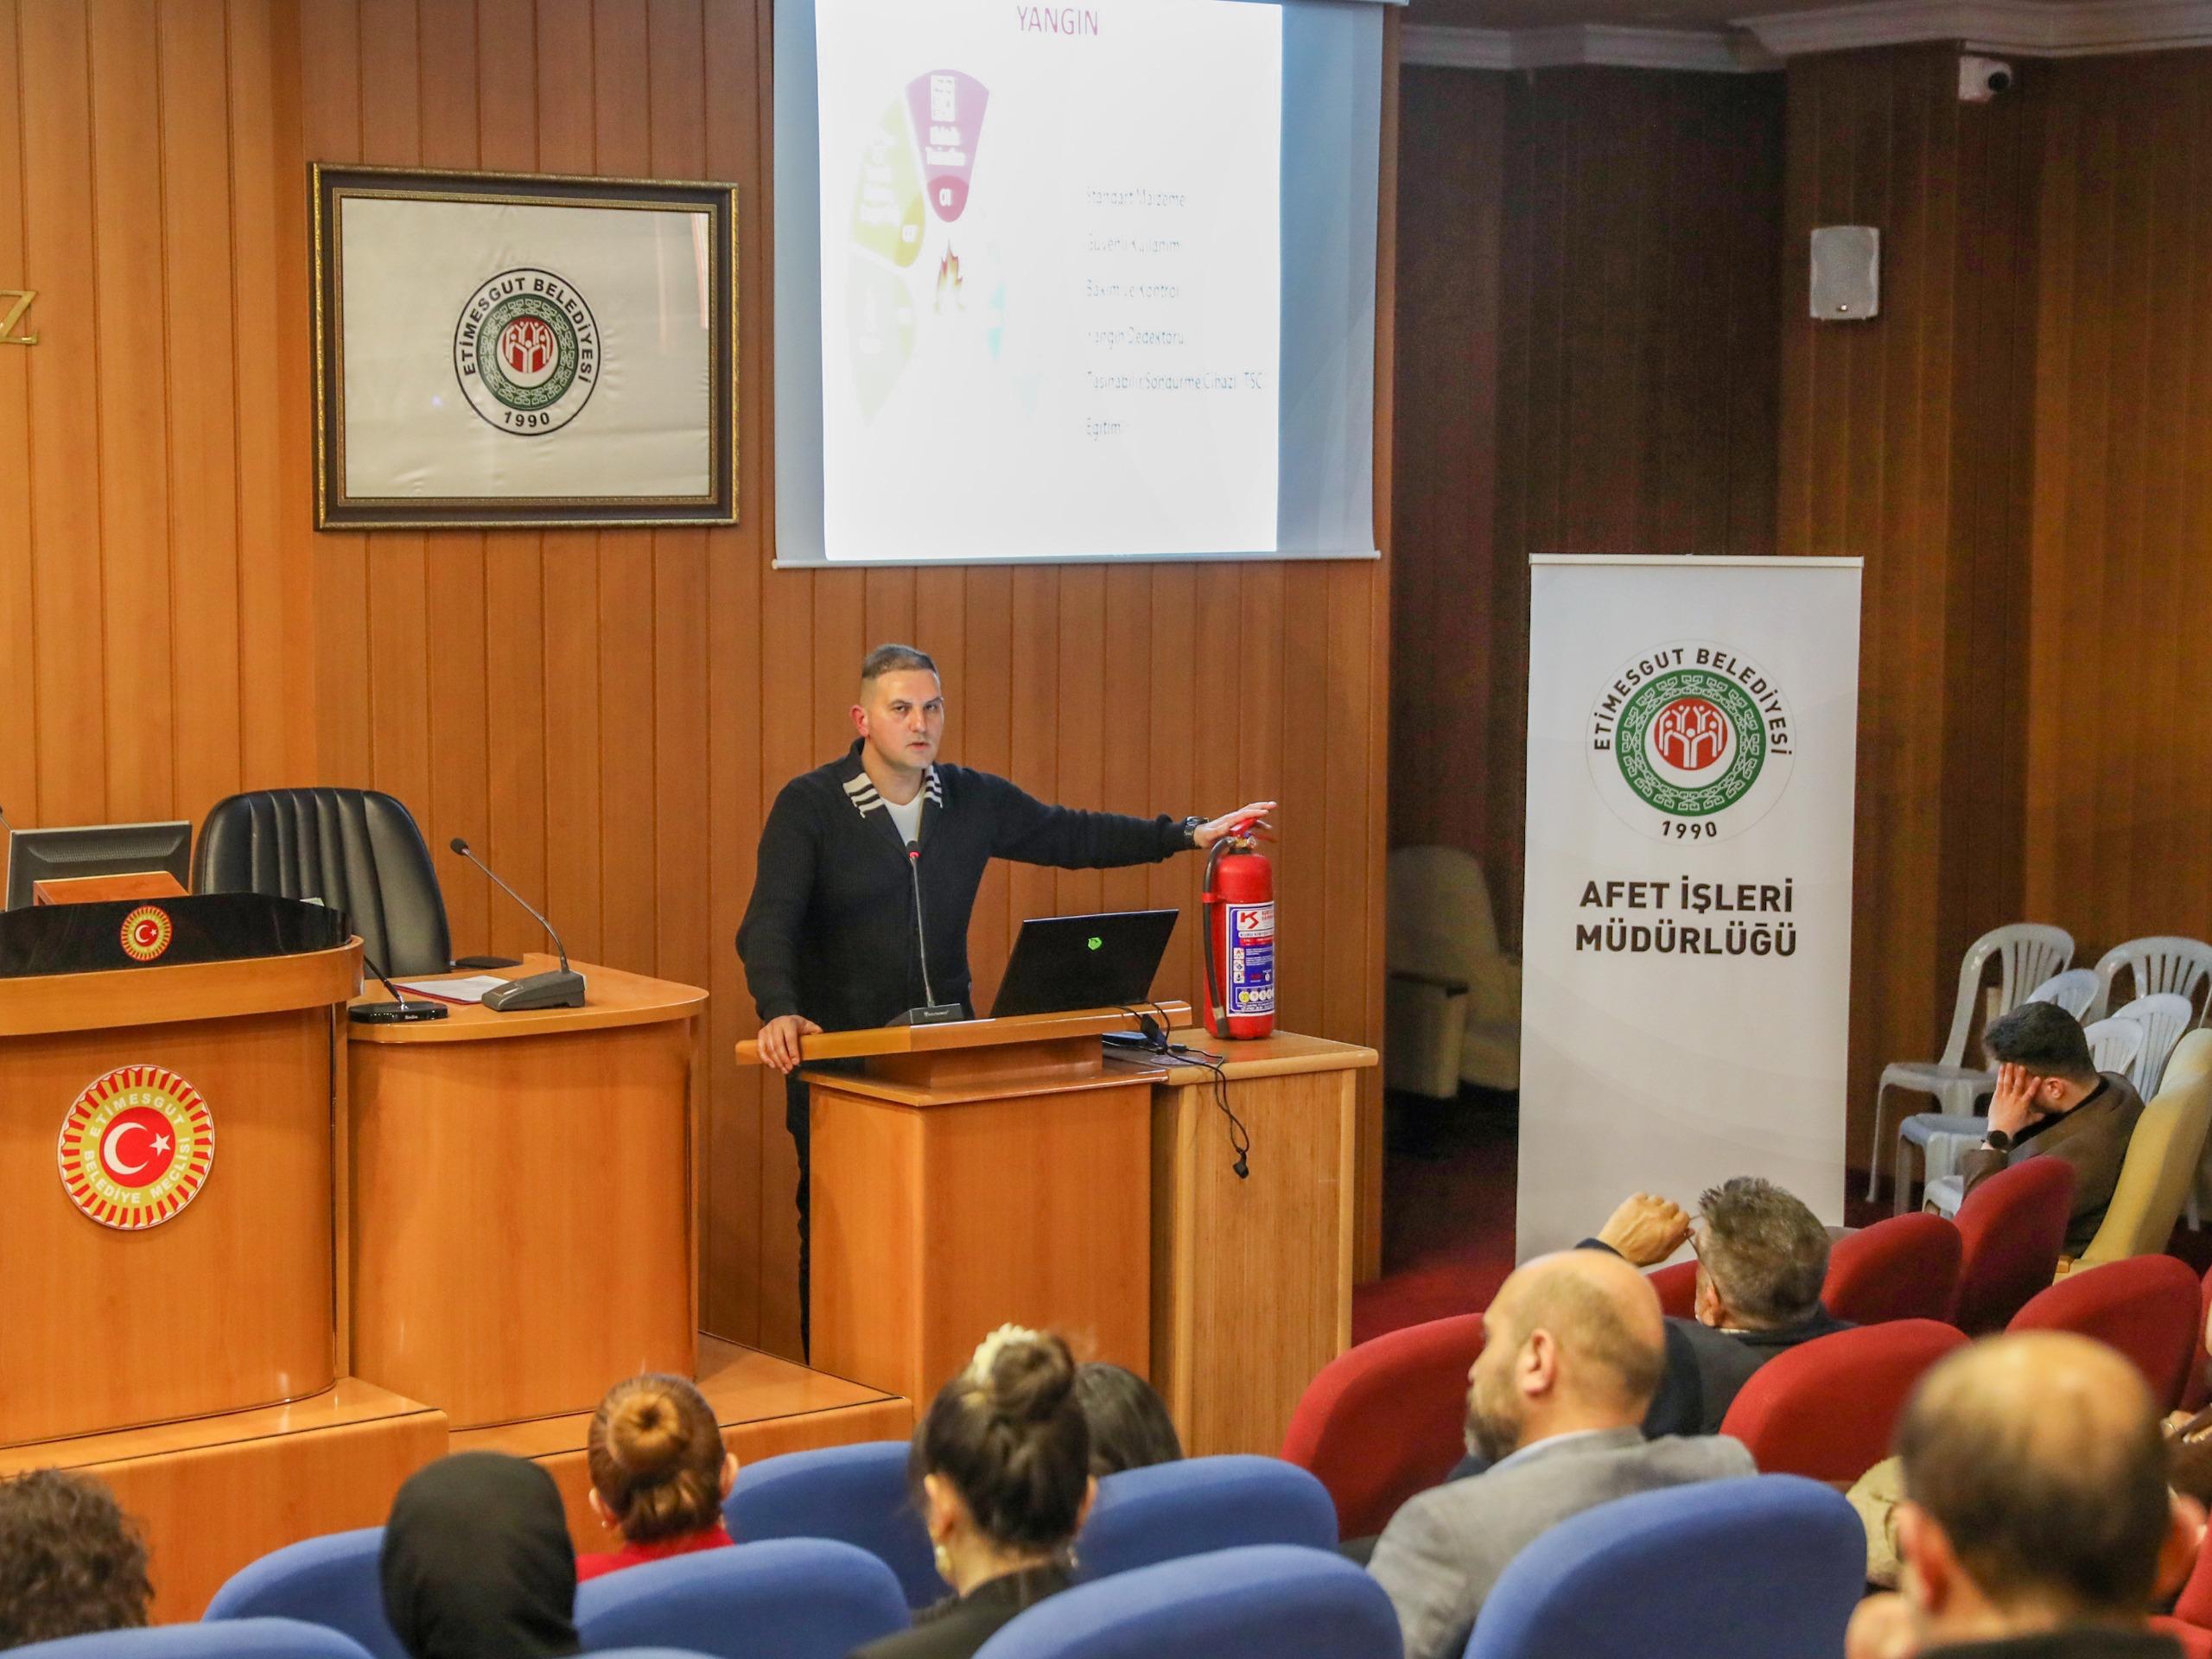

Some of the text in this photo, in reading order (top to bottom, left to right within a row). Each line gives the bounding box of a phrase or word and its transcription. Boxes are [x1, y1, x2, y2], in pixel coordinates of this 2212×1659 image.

[1016, 5, 1098, 36] YANGIN
[459, 276, 594, 385] ETİMESGUT BELEDİYESİ
[504, 410, 550, 428] 1990
[1593, 647, 1793, 756] ETİMESGUT BELEDİYESİ
[1661, 819, 1719, 841] 1990
[1579, 874, 1794, 915] AFET İŞLERİ
[1575, 917, 1797, 957] MÜDÜRLÜĞÜ
[89, 1092, 186, 1139] ETİMESGUT
[83, 1136, 192, 1205] BELEDİYE MECLİSİ
